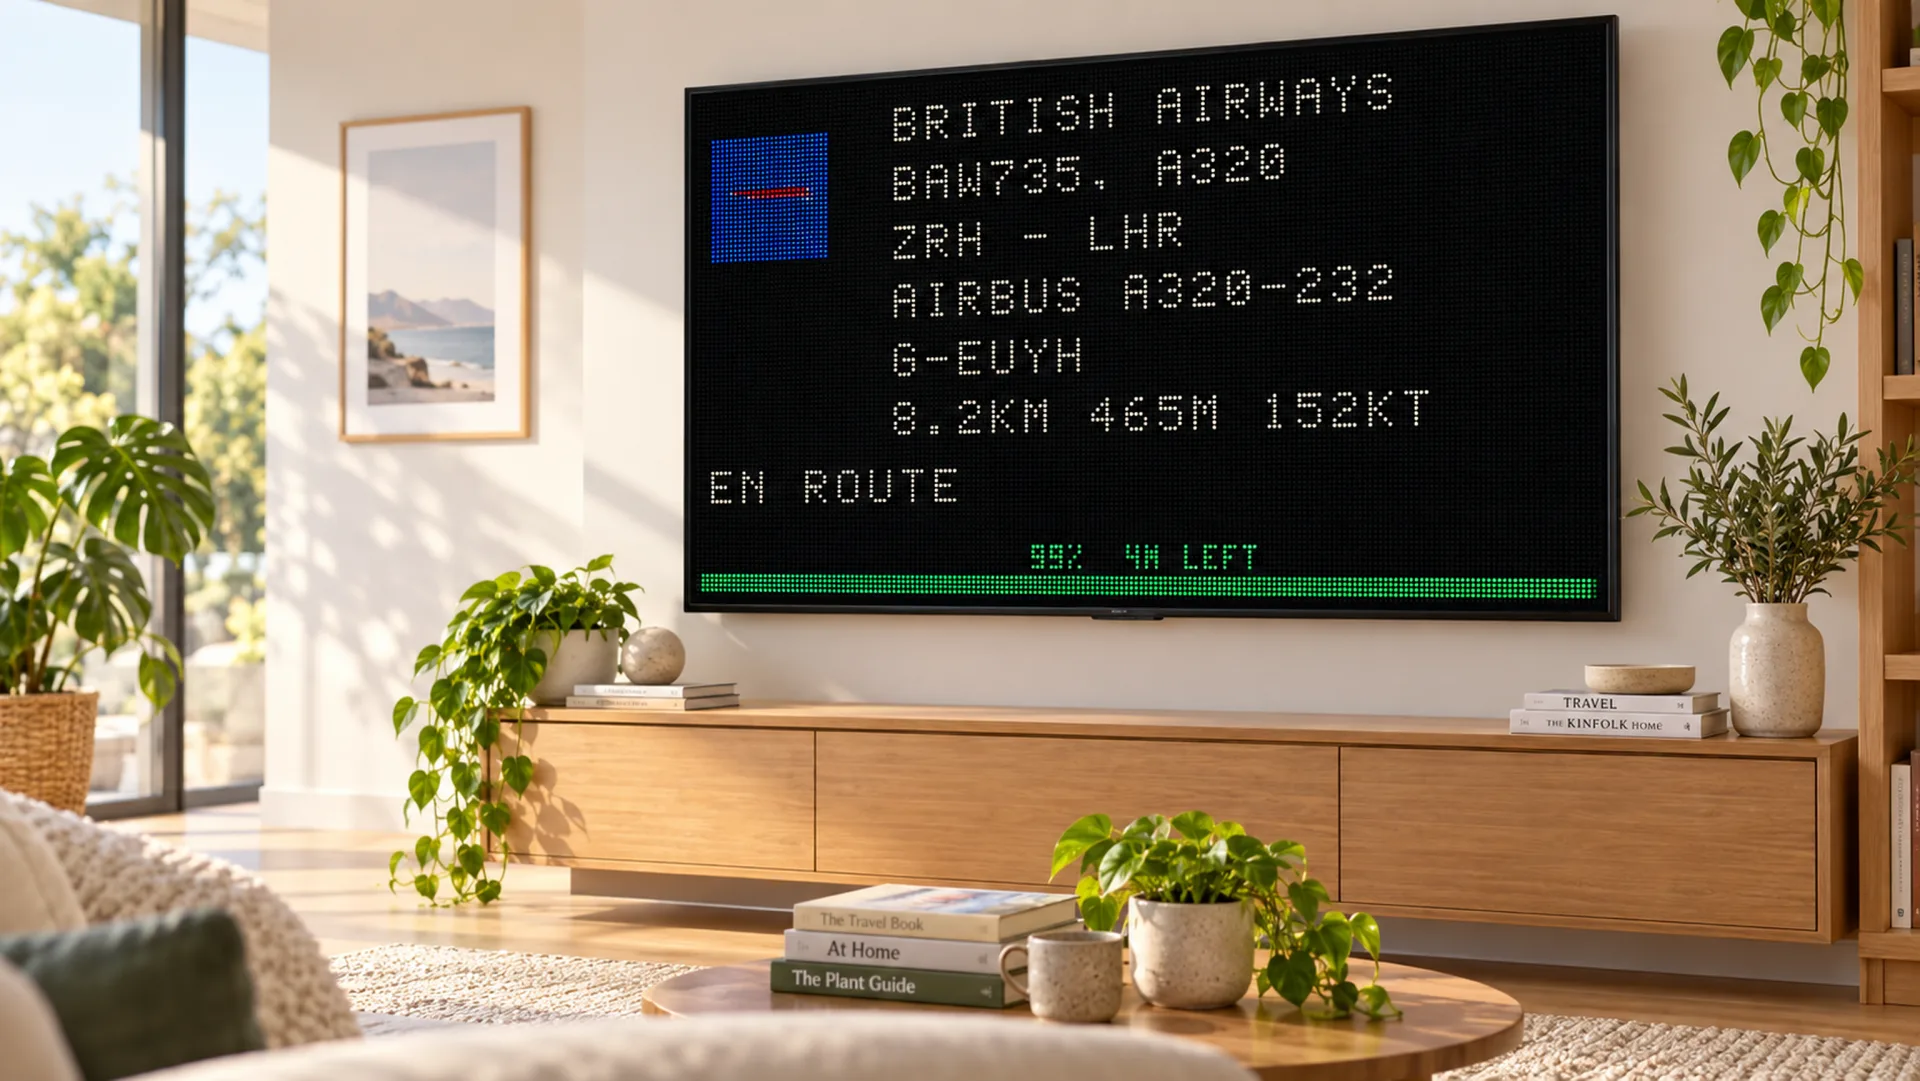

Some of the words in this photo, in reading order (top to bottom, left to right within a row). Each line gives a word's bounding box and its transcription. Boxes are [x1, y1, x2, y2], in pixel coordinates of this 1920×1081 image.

[893, 92, 1113, 142] BRITISH
[1157, 72, 1393, 125] AIRWAYS
[1157, 143, 1285, 187] A320
[893, 221, 981, 261] ZRH
[1089, 211, 1182, 251] LHR
[893, 276, 1081, 319] AIRBUS
[1124, 263, 1393, 310] A320-232
[893, 337, 1081, 378] G-EUYH
[892, 398, 1048, 436] 8.2KM
[1090, 394, 1217, 432] 465M
[1266, 389, 1430, 429] 152KT
[710, 470, 764, 505] EN
[804, 468, 958, 504] ROUTE
[1030, 543, 1082, 570] 99%
[1125, 543, 1160, 570] 4M
[1183, 543, 1258, 570] LEFT
[1563, 696, 1618, 710] TRAVEL
[1546, 719, 1564, 728] THE
[1567, 717, 1629, 730] KINFOLK
[820, 912, 845, 927] The
[848, 914, 887, 929] Travel
[890, 916, 924, 931] Book
[827, 940, 847, 957] At
[852, 941, 901, 960] Home
[791, 969, 822, 987] The
[825, 971, 865, 990] Plant
[868, 975, 916, 994] Guide
